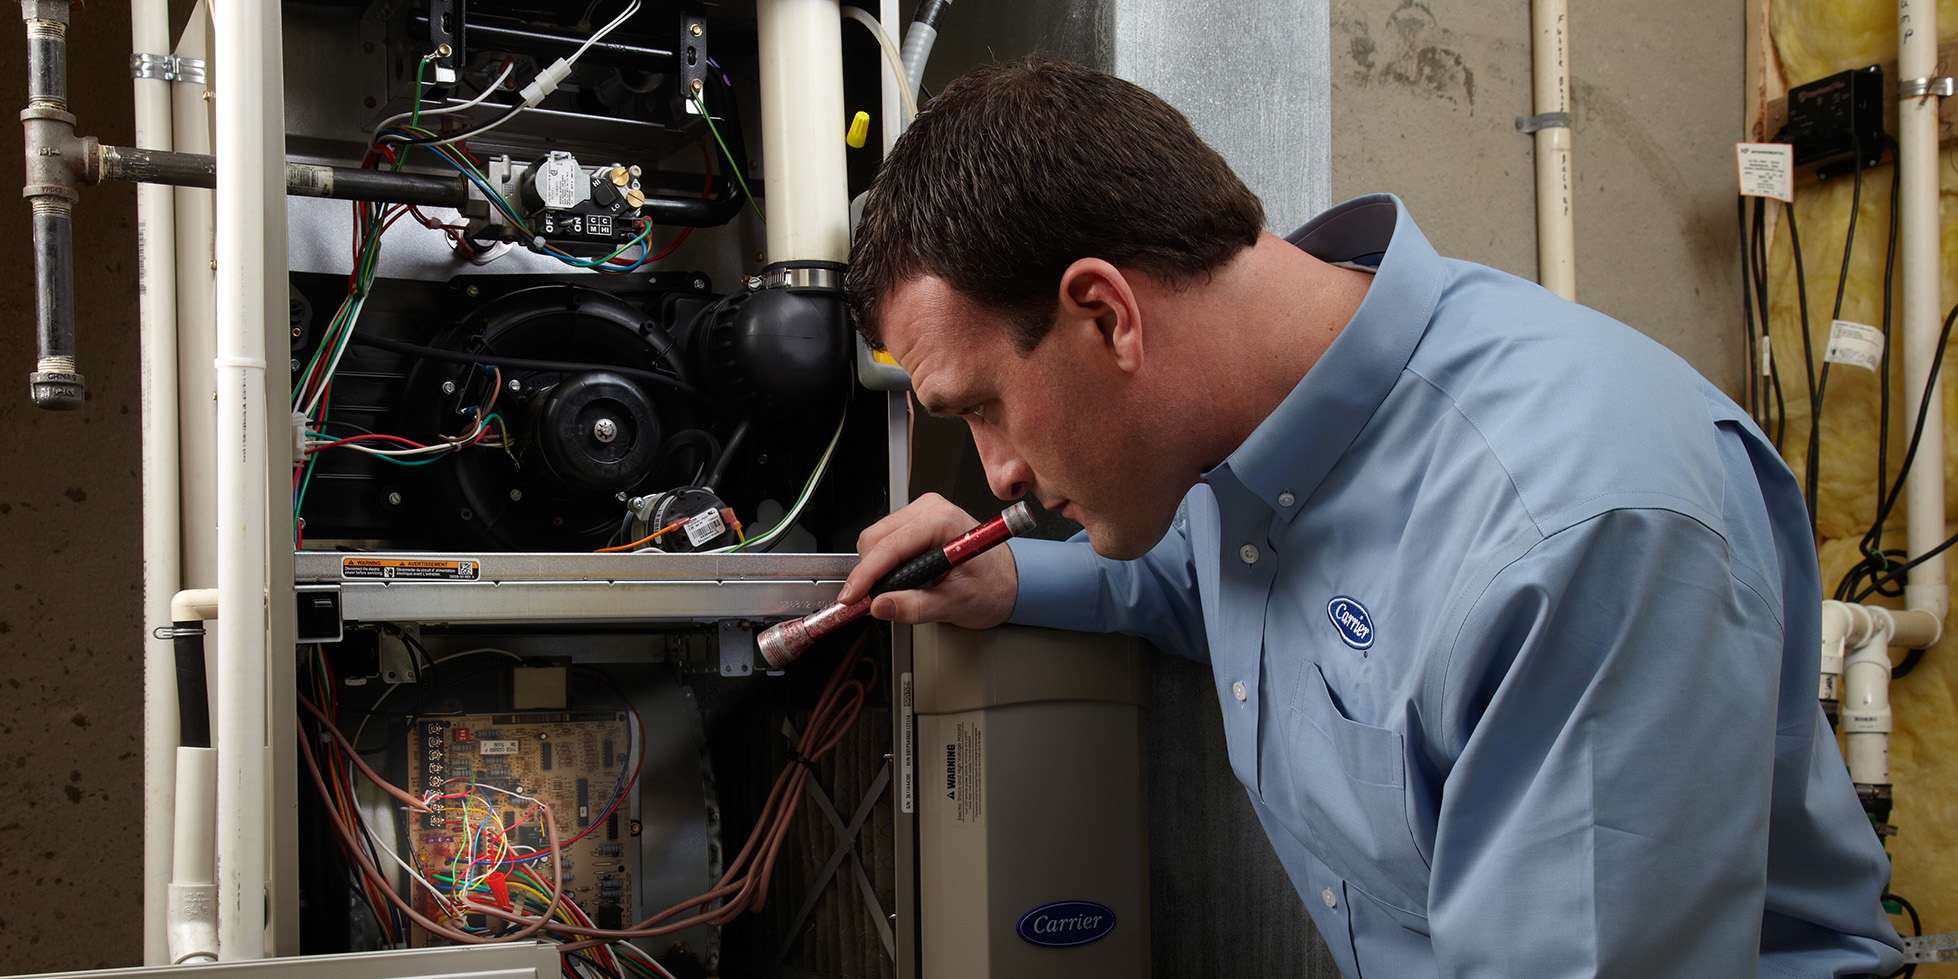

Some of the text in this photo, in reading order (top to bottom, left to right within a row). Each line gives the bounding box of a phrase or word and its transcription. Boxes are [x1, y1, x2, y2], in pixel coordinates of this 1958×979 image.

[592, 179, 601, 188] HI
[611, 203, 621, 212] LO
[546, 213, 554, 233] OFF
[574, 217, 582, 232] ON
[1335, 603, 1370, 640] Carrier
[946, 744, 956, 789] WARNING
[1033, 913, 1103, 935] Carrier
